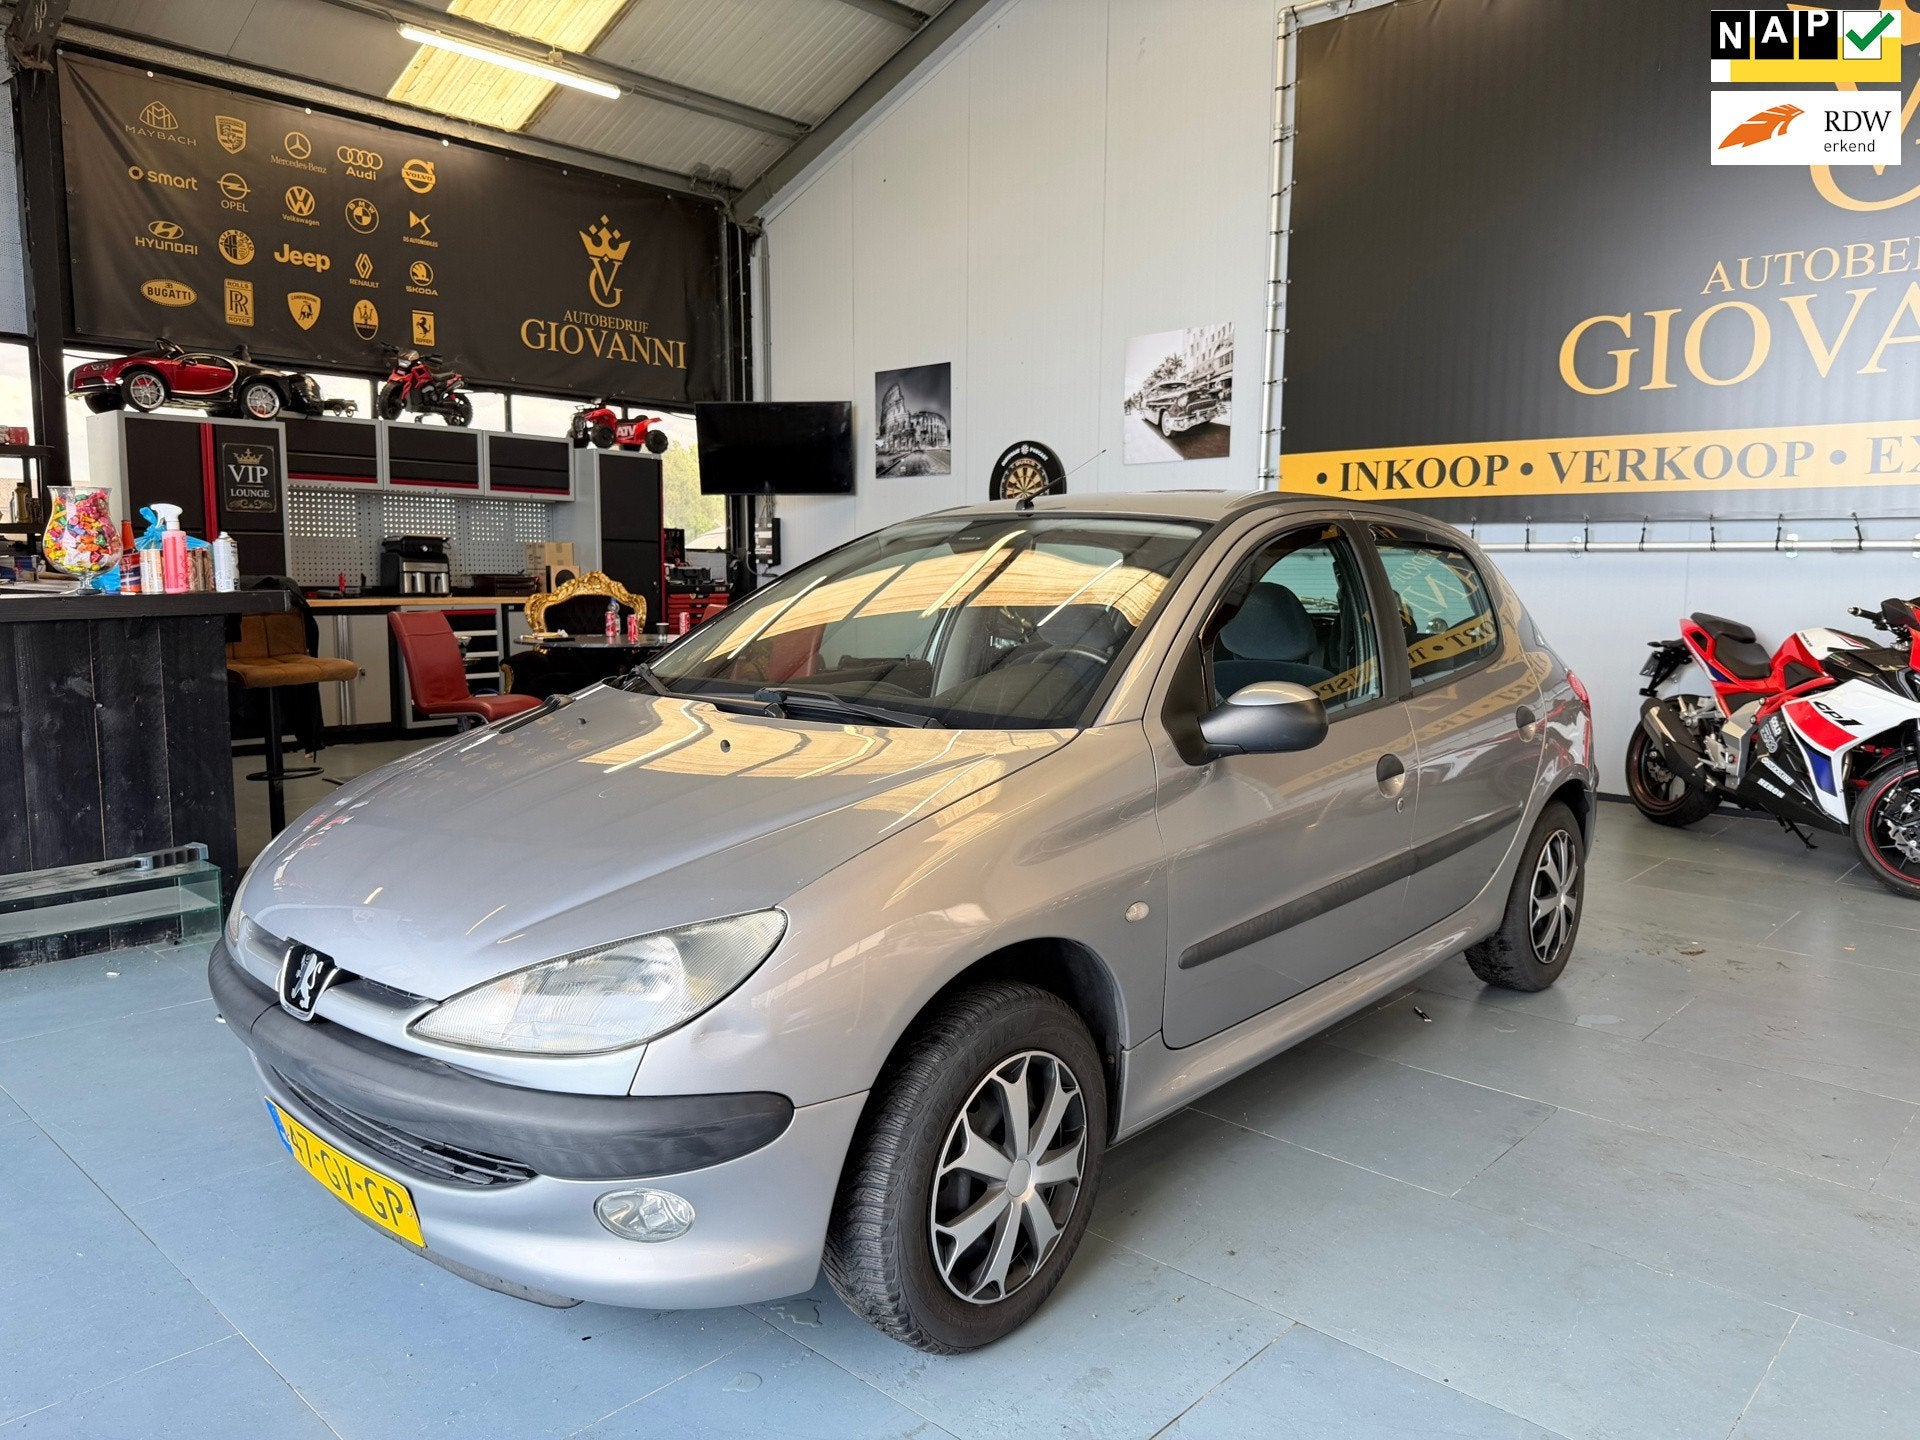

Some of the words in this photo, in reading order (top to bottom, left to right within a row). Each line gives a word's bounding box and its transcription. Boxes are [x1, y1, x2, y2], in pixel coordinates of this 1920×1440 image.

[125, 124, 197, 146] MAYBACH
[147, 170, 198, 191] smart
[346, 166, 377, 181] Audi
[405, 171, 433, 182] VOLVO
[220, 199, 249, 213] OPEL
[282, 213, 320, 227] Volkswagen
[135, 236, 198, 255] HYUNDAI
[273, 243, 331, 273] Jeep
[349, 278, 379, 289] RENAULT
[147, 286, 191, 301] BUGATTI
[563, 310, 649, 334] AUTOBEDRIJF
[520, 318, 688, 370] GIOVANNI
[616, 425, 636, 437] ATV
[227, 464, 269, 484] VIP
[1338, 454, 1509, 493] INKOOP
[1547, 441, 1815, 485] VERKOOP
[230, 488, 271, 498] LOUNGE
[287, 1124, 404, 1228] 47-GV-GP
